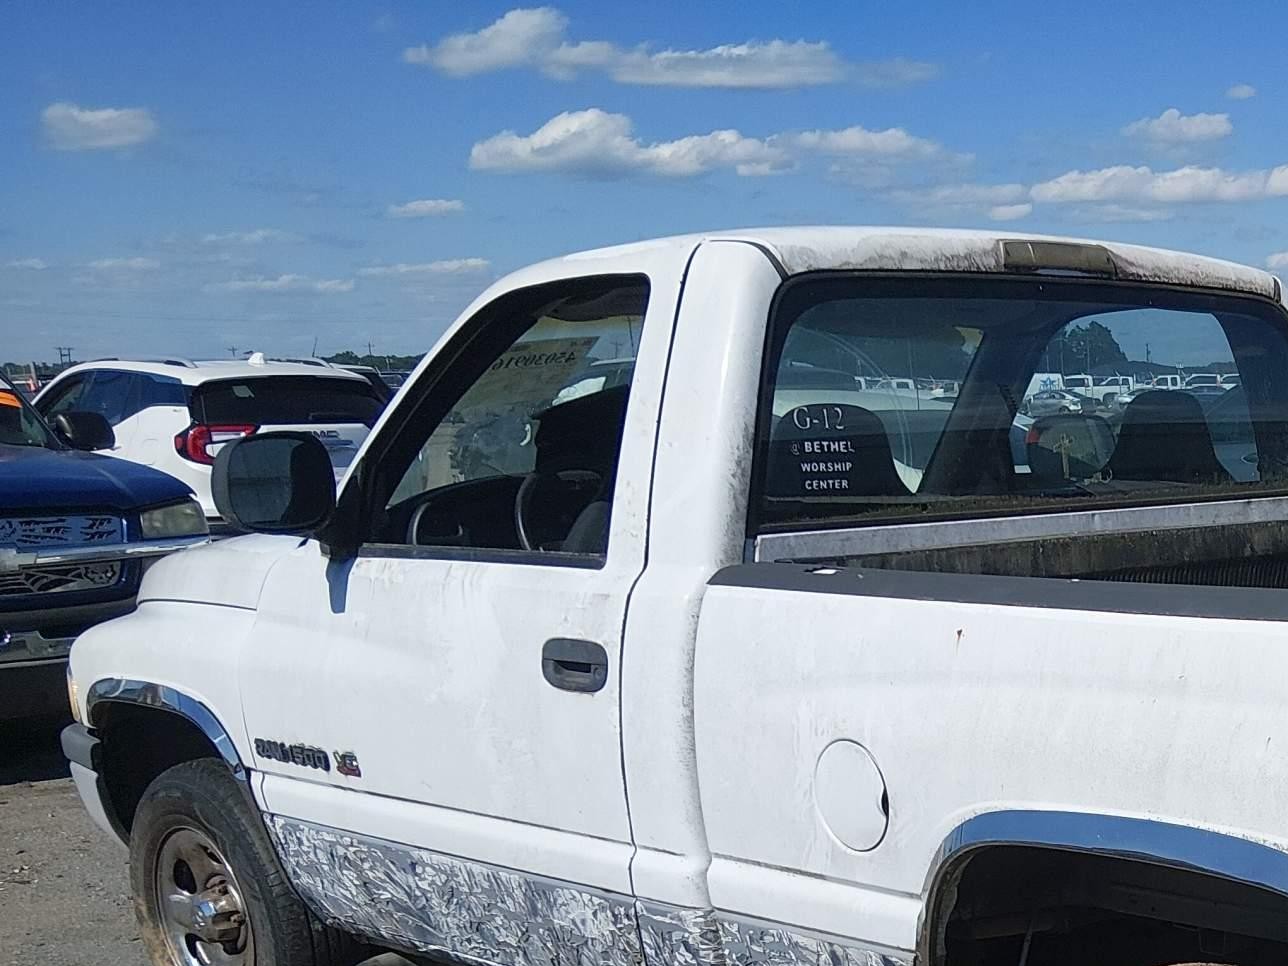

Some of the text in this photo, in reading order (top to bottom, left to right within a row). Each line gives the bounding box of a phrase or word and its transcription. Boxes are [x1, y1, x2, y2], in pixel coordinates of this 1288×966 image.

[793, 406, 845, 430] G-12
[804, 441, 855, 453] BETHEL
[800, 462, 852, 472] WORSHIP
[805, 479, 849, 490] CENTER
